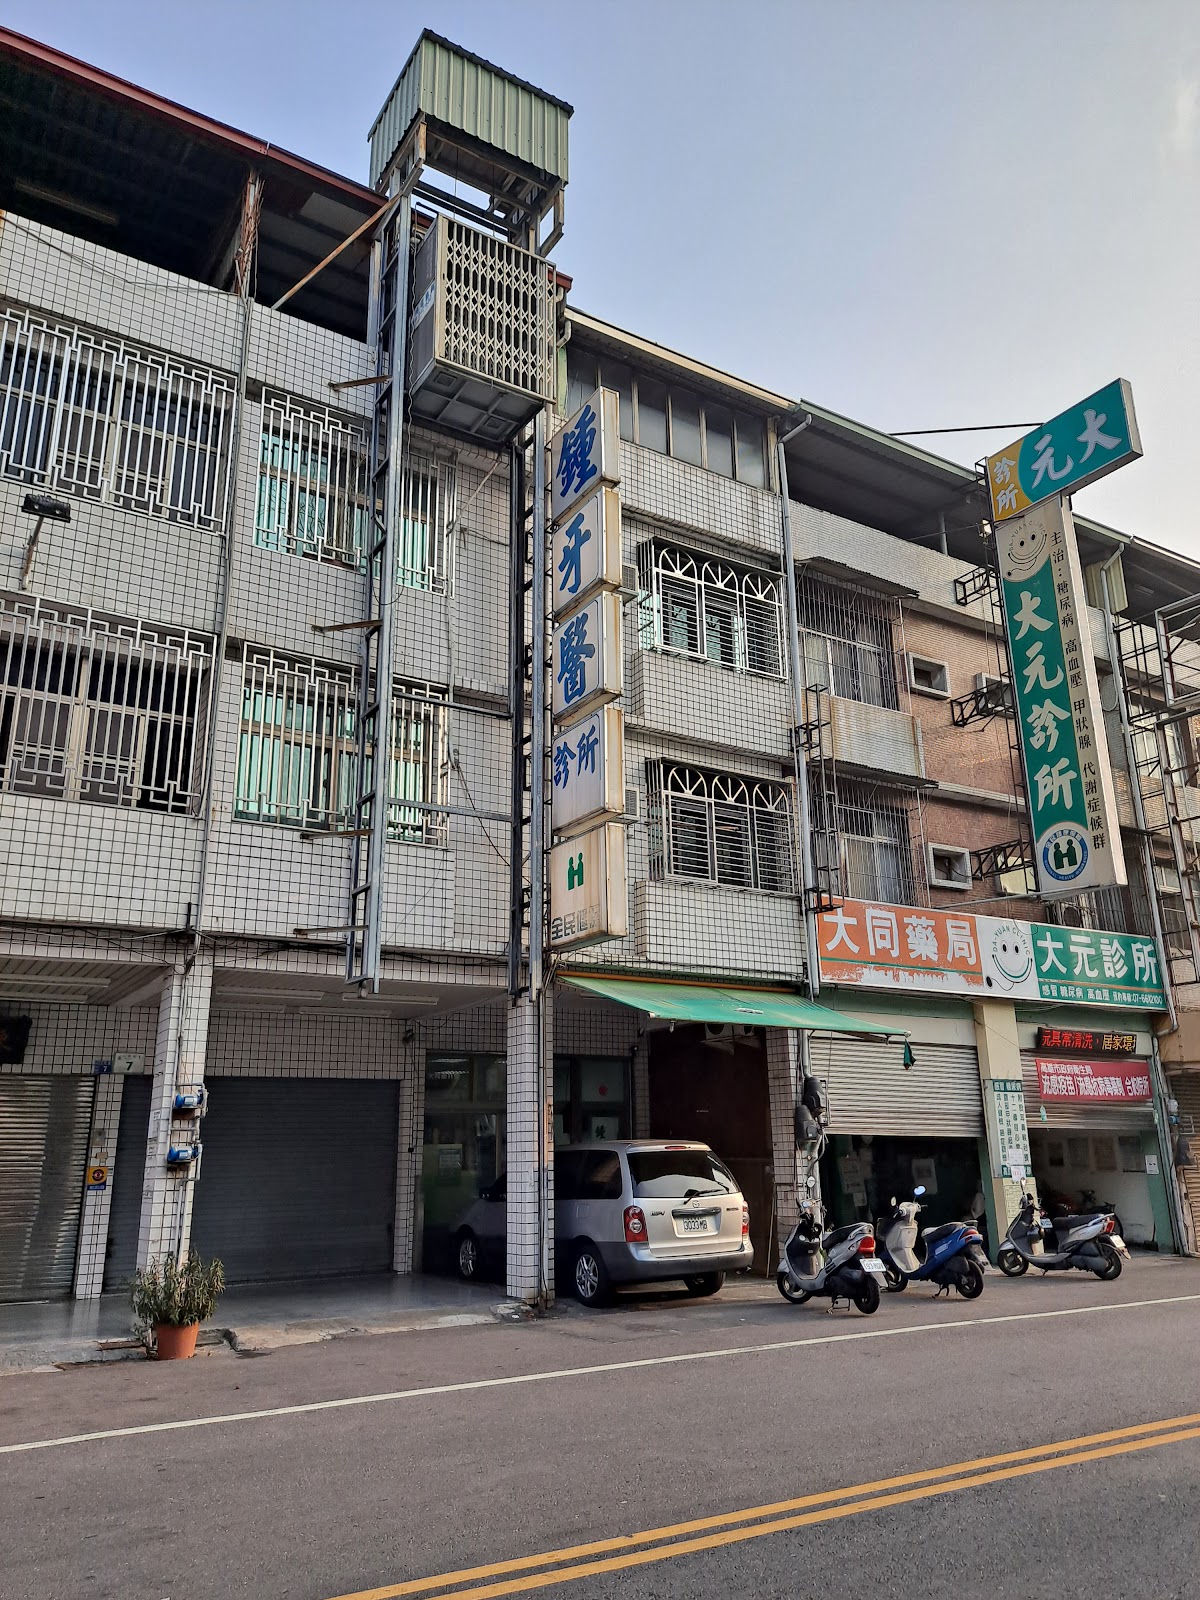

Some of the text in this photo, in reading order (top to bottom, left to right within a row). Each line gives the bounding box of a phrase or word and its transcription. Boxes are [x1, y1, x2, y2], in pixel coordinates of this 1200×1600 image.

[993, 456, 1019, 515] 診所
[1012, 590, 1078, 812] 大元診所
[553, 724, 599, 790] 診所
[1065, 639, 1083, 689] 高血壓
[1074, 698, 1092, 749] 甲狀腺
[1083, 762, 1106, 850] 代謝症候群
[822, 908, 978, 966] 大同藥局
[992, 925, 1031, 955] DA-YUAN CLINIC
[1036, 931, 1158, 985] 大元診所
[1041, 984, 1058, 997] 感冒
[1060, 985, 1084, 999] 糖尿病
[1087, 988, 1110, 1001] 高血壓
[126, 1061, 133, 1071] 7
